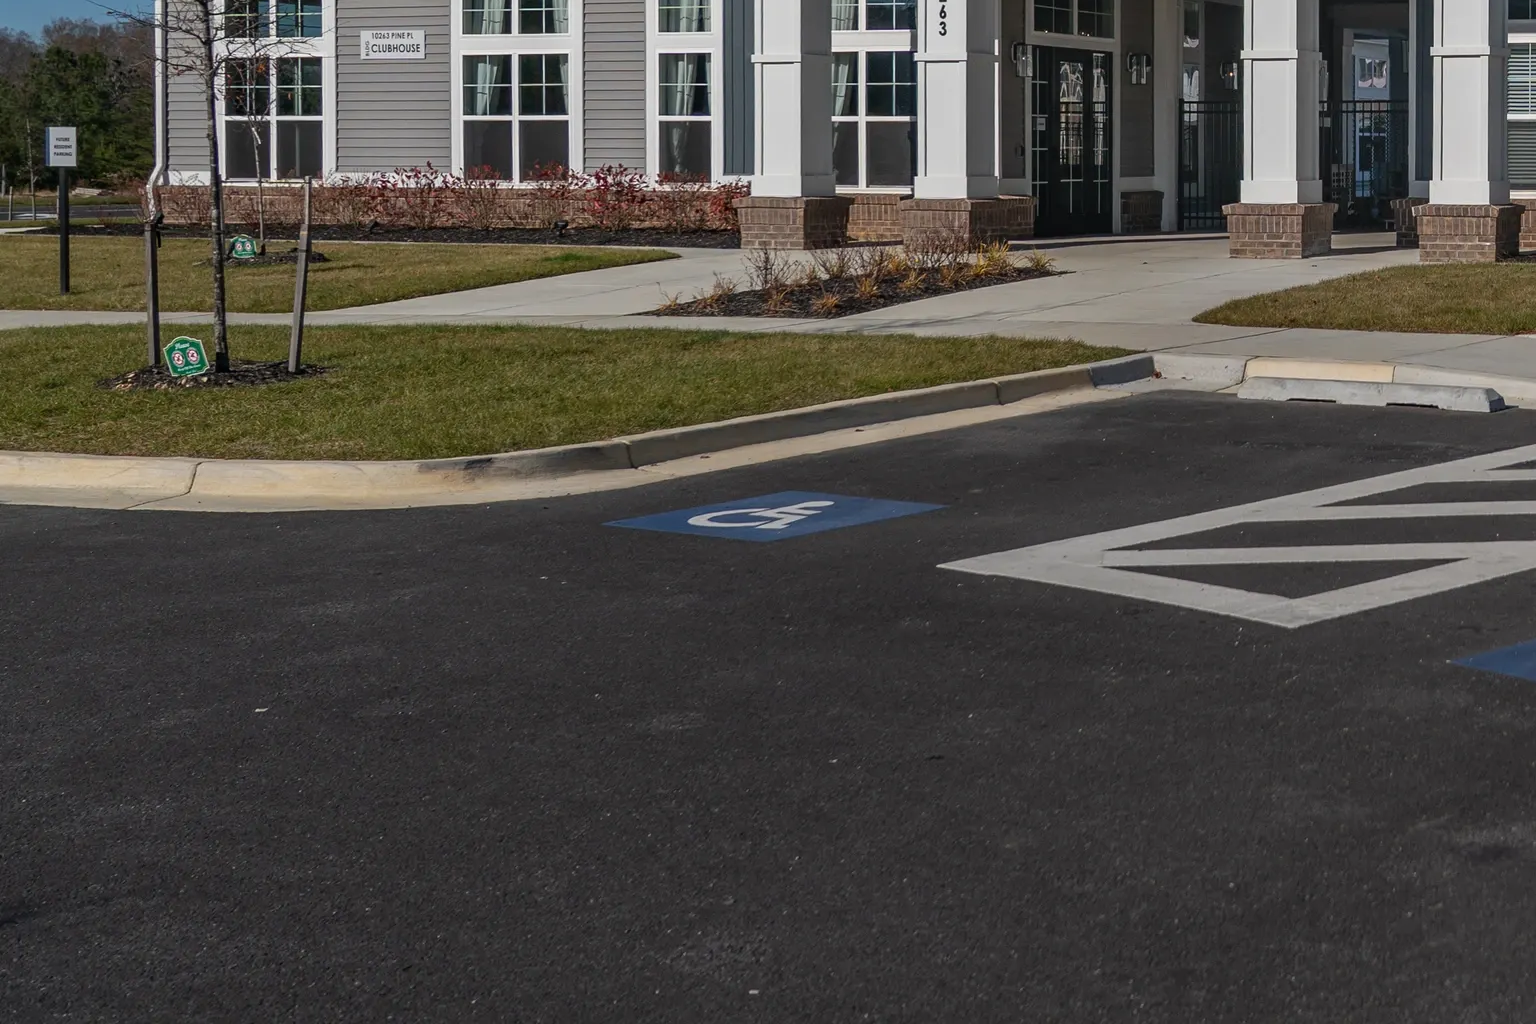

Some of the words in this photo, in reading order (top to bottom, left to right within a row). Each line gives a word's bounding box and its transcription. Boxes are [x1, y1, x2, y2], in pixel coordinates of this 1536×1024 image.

[371, 32, 390, 40] 10263
[391, 32, 406, 40] PINE
[406, 32, 414, 40] PL
[371, 43, 421, 53] CLUBHOUSE
